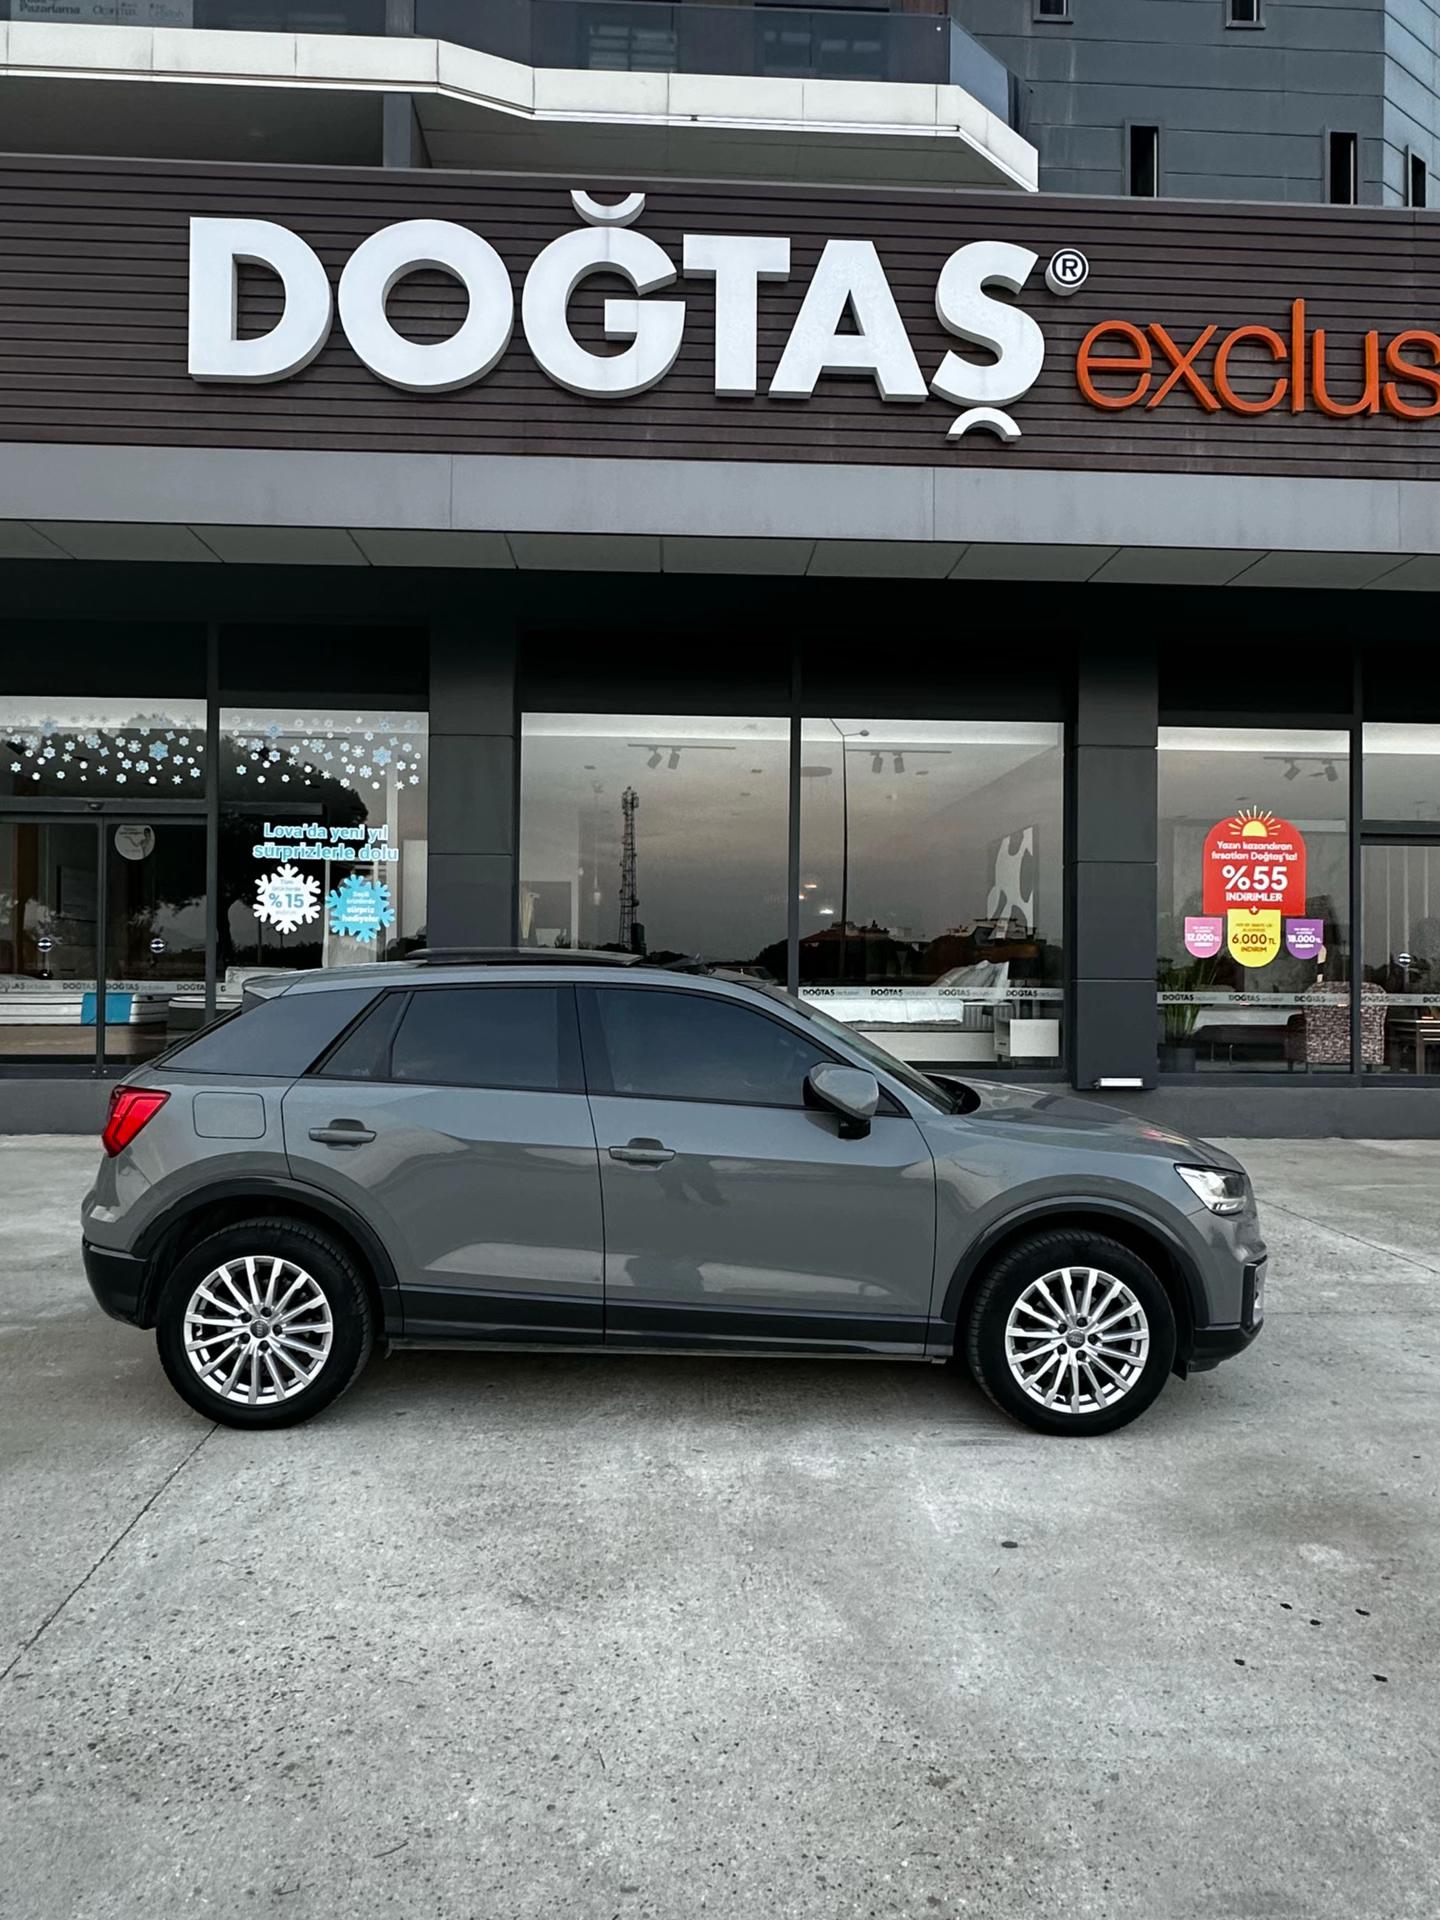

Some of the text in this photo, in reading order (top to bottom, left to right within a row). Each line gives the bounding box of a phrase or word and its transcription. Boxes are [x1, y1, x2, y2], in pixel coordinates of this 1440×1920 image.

[188, 190, 1043, 441] DOĞTAŞ
[263, 822, 389, 843] Lova'da yeni yıl
[252, 841, 399, 862] sürprizlerle dolu
[1221, 864, 1289, 892] %55
[268, 892, 305, 909] %15
[1231, 933, 1268, 945] 6.000
